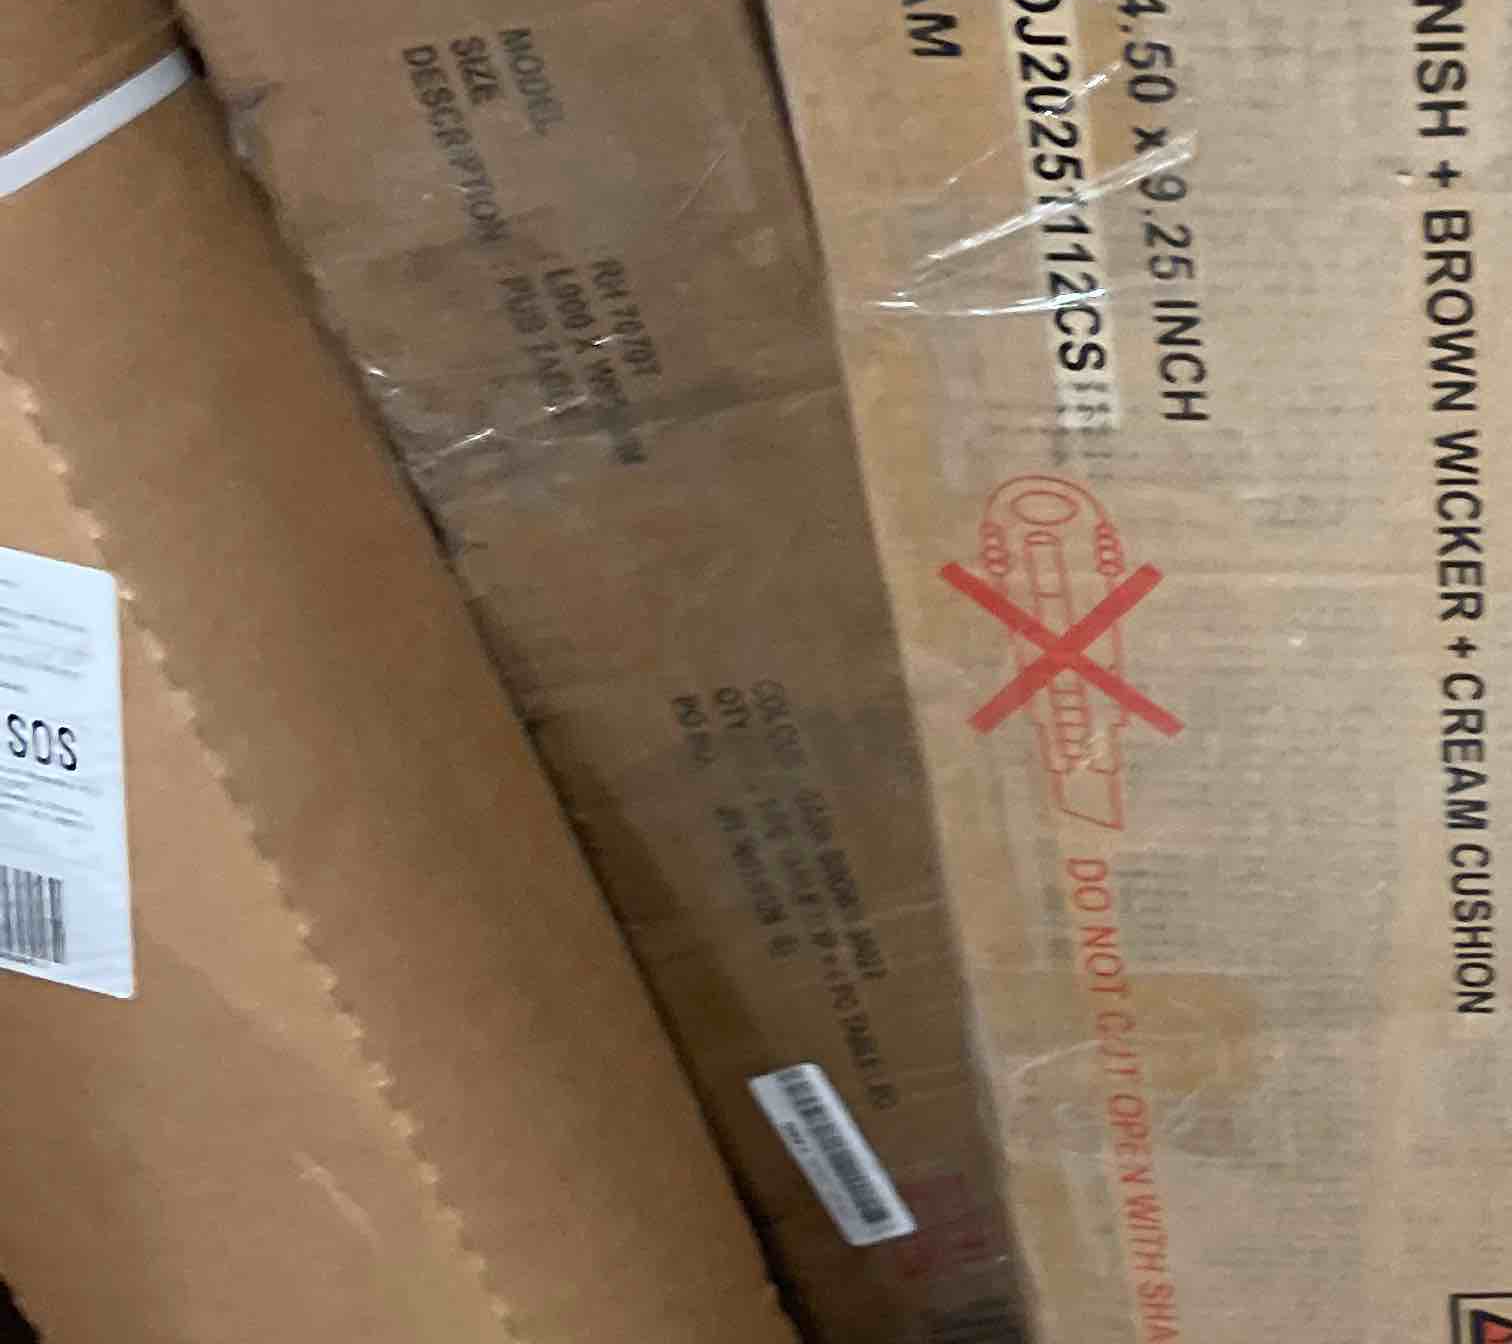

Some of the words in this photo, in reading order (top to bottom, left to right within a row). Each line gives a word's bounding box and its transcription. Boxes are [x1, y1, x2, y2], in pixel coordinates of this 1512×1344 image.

[449, 36, 504, 104] SIZE
[498, 28, 565, 136] MODEL
[401, 44, 512, 244] DESCRIPTION
[1427, 161, 1460, 191] +
[1137, 175, 1192, 280] 9.25
[1152, 300, 1209, 423] INCH
[1424, 209, 1477, 413] BROWN
[1433, 430, 1482, 620] WICKER
[1446, 636, 1470, 658] +
[1444, 672, 1487, 830] CREAM
[1065, 855, 1117, 915] DO
[1451, 844, 1496, 1015] CUSHION
[1079, 925, 1126, 1002] NOT
[1106, 1091, 1153, 1189] OPEN
[1124, 1193, 1170, 1276] WITH
